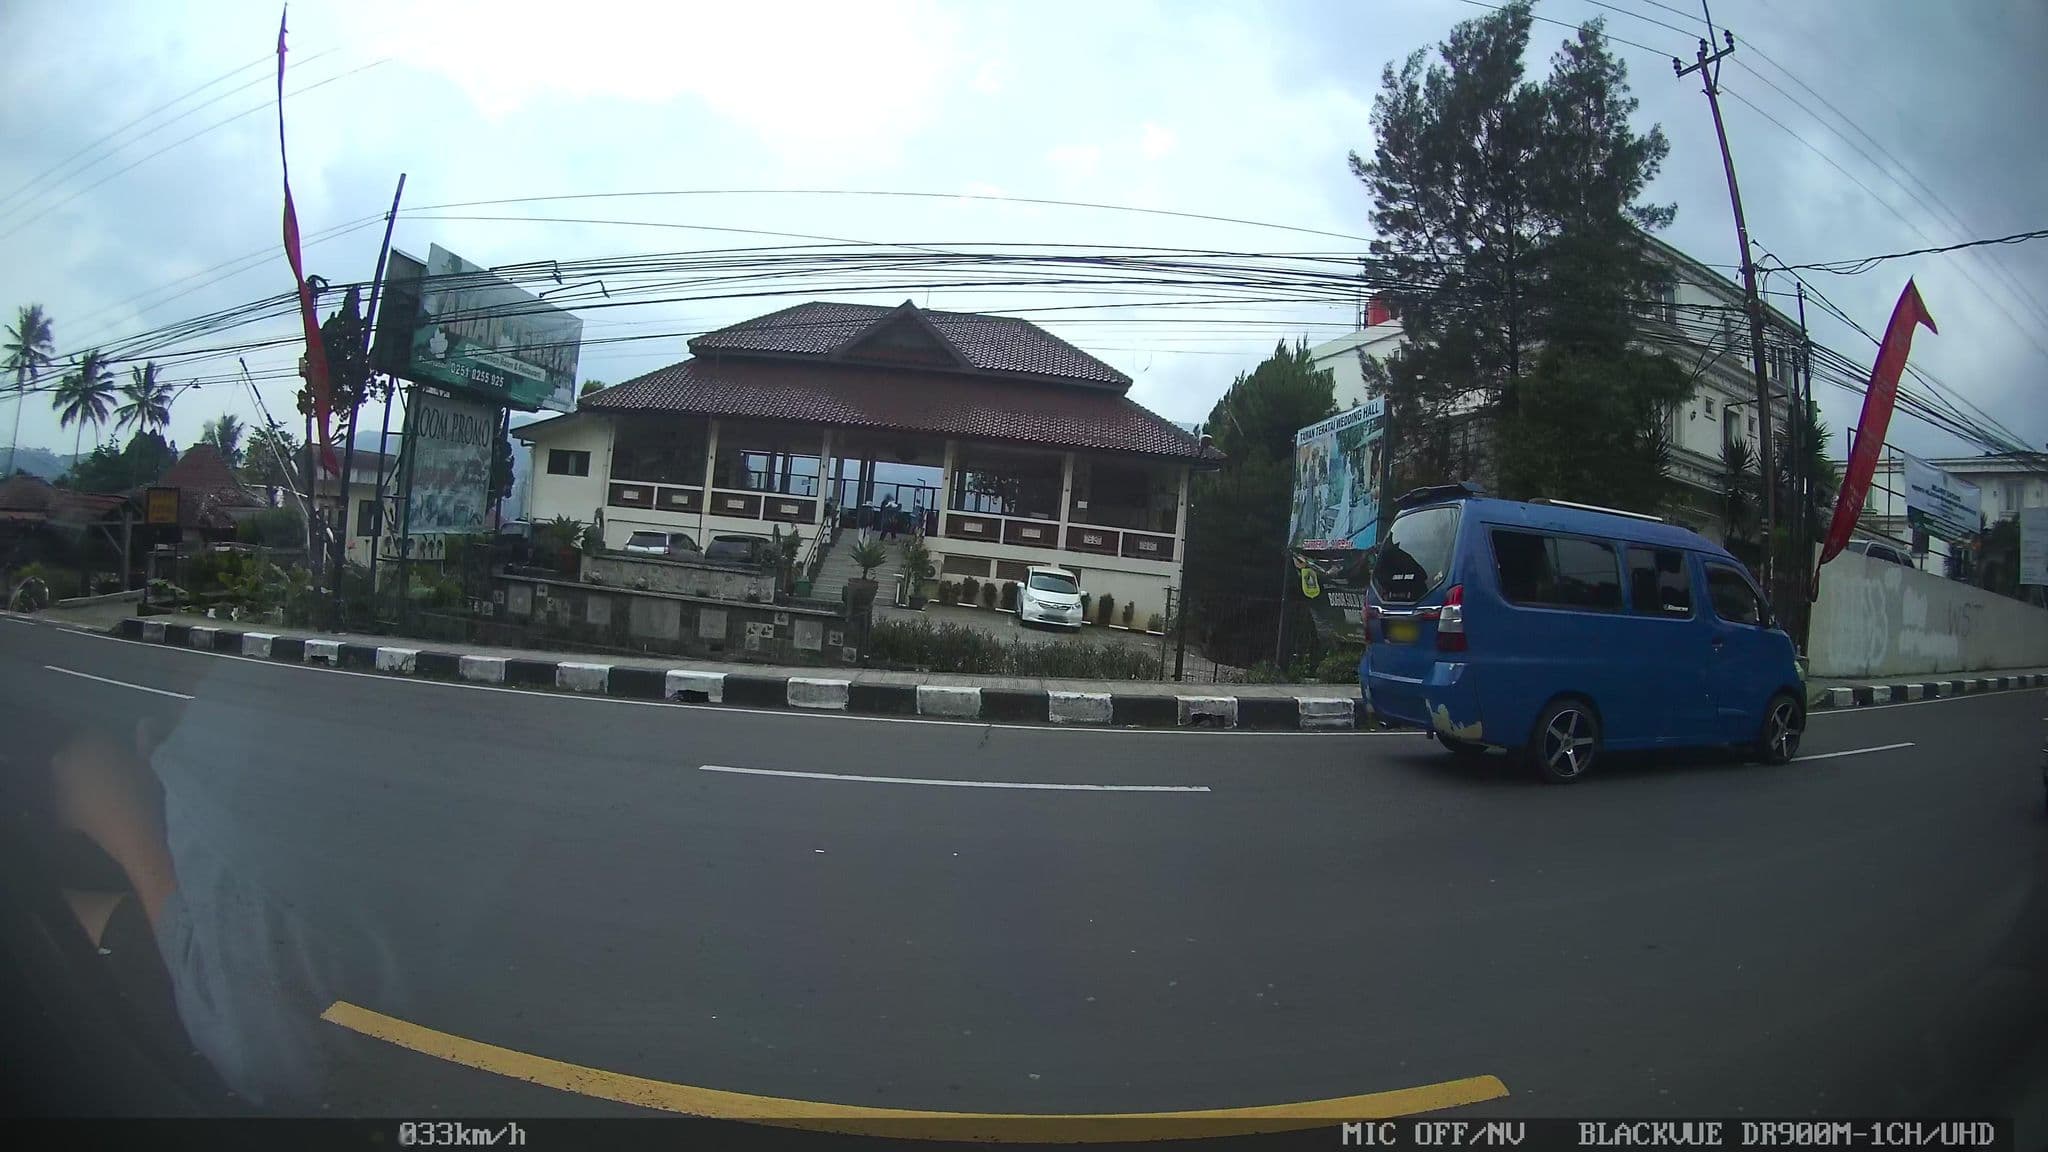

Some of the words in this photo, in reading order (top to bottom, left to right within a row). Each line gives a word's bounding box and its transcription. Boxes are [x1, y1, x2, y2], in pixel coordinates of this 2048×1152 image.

[451, 412, 490, 447] PROMO
[1336, 409, 1362, 430] WEDDING
[1363, 402, 1380, 419] HALL
